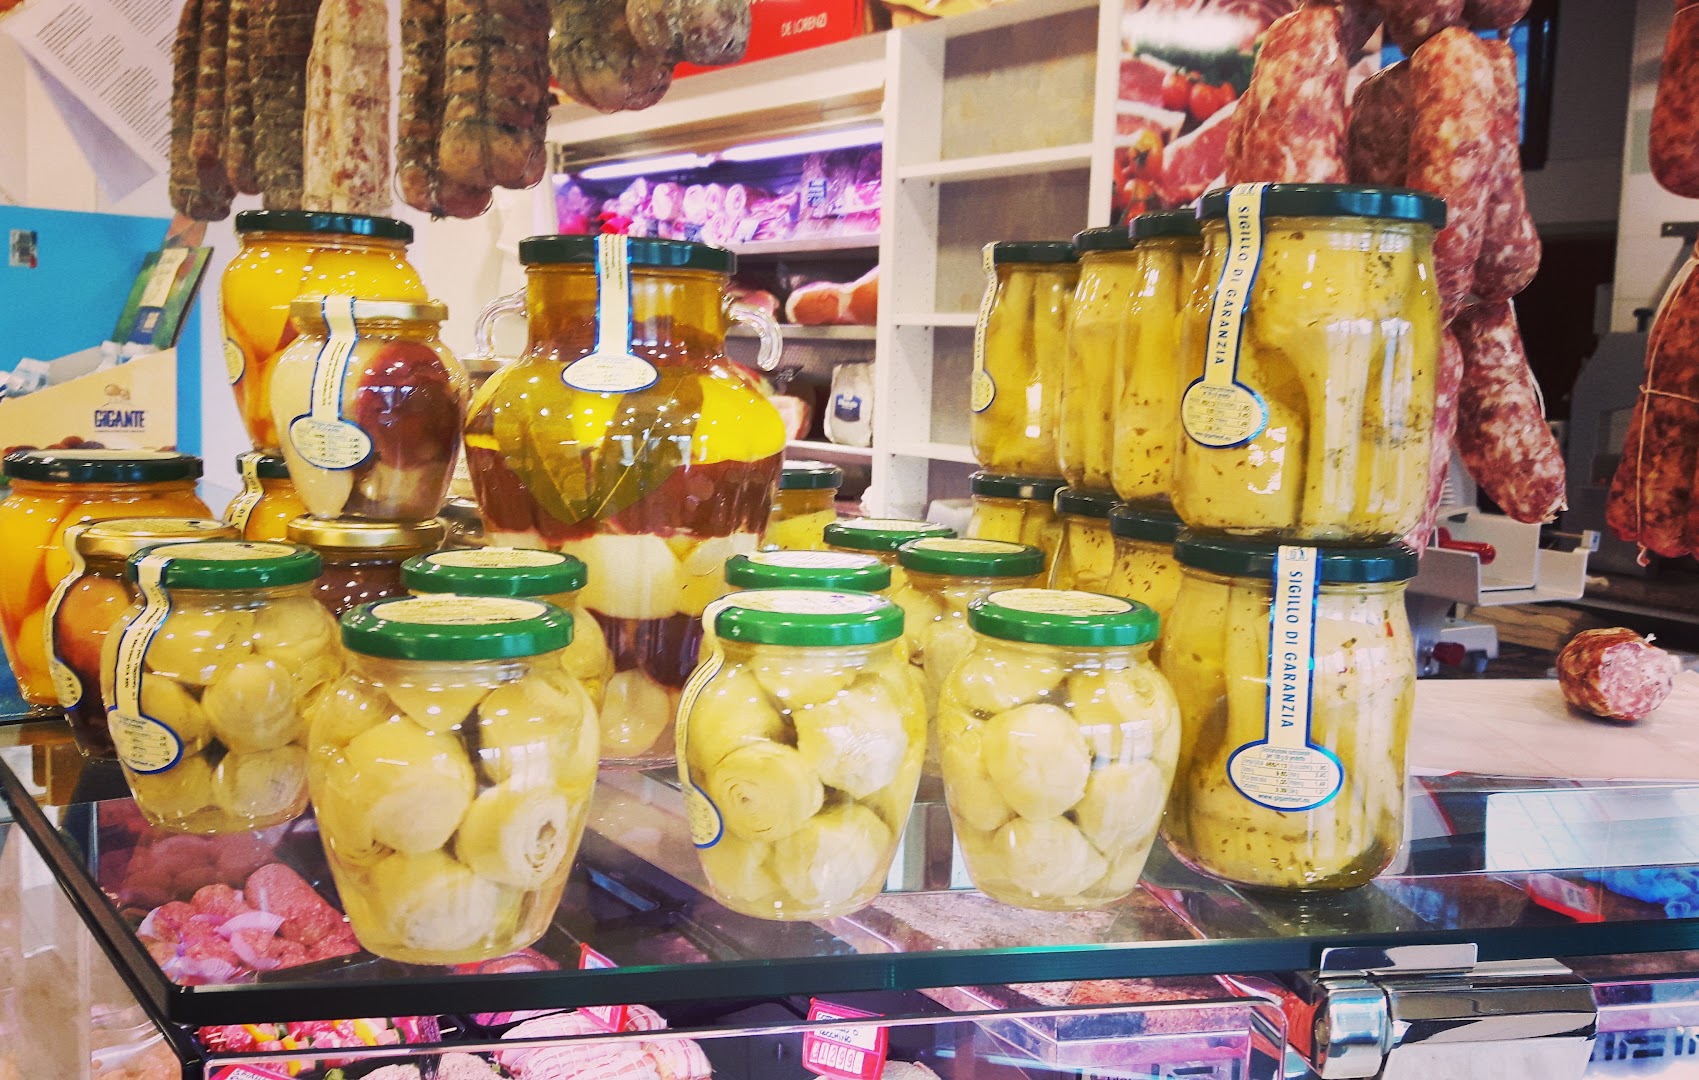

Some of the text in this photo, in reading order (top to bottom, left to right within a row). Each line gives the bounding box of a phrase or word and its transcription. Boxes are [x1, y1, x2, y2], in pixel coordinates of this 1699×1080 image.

[1214, 205, 1251, 365] SIGILLO DI GARANZIA
[94, 409, 145, 428] GIGANTE
[1280, 571, 1303, 728] SIGILLO DI GARANZIA
